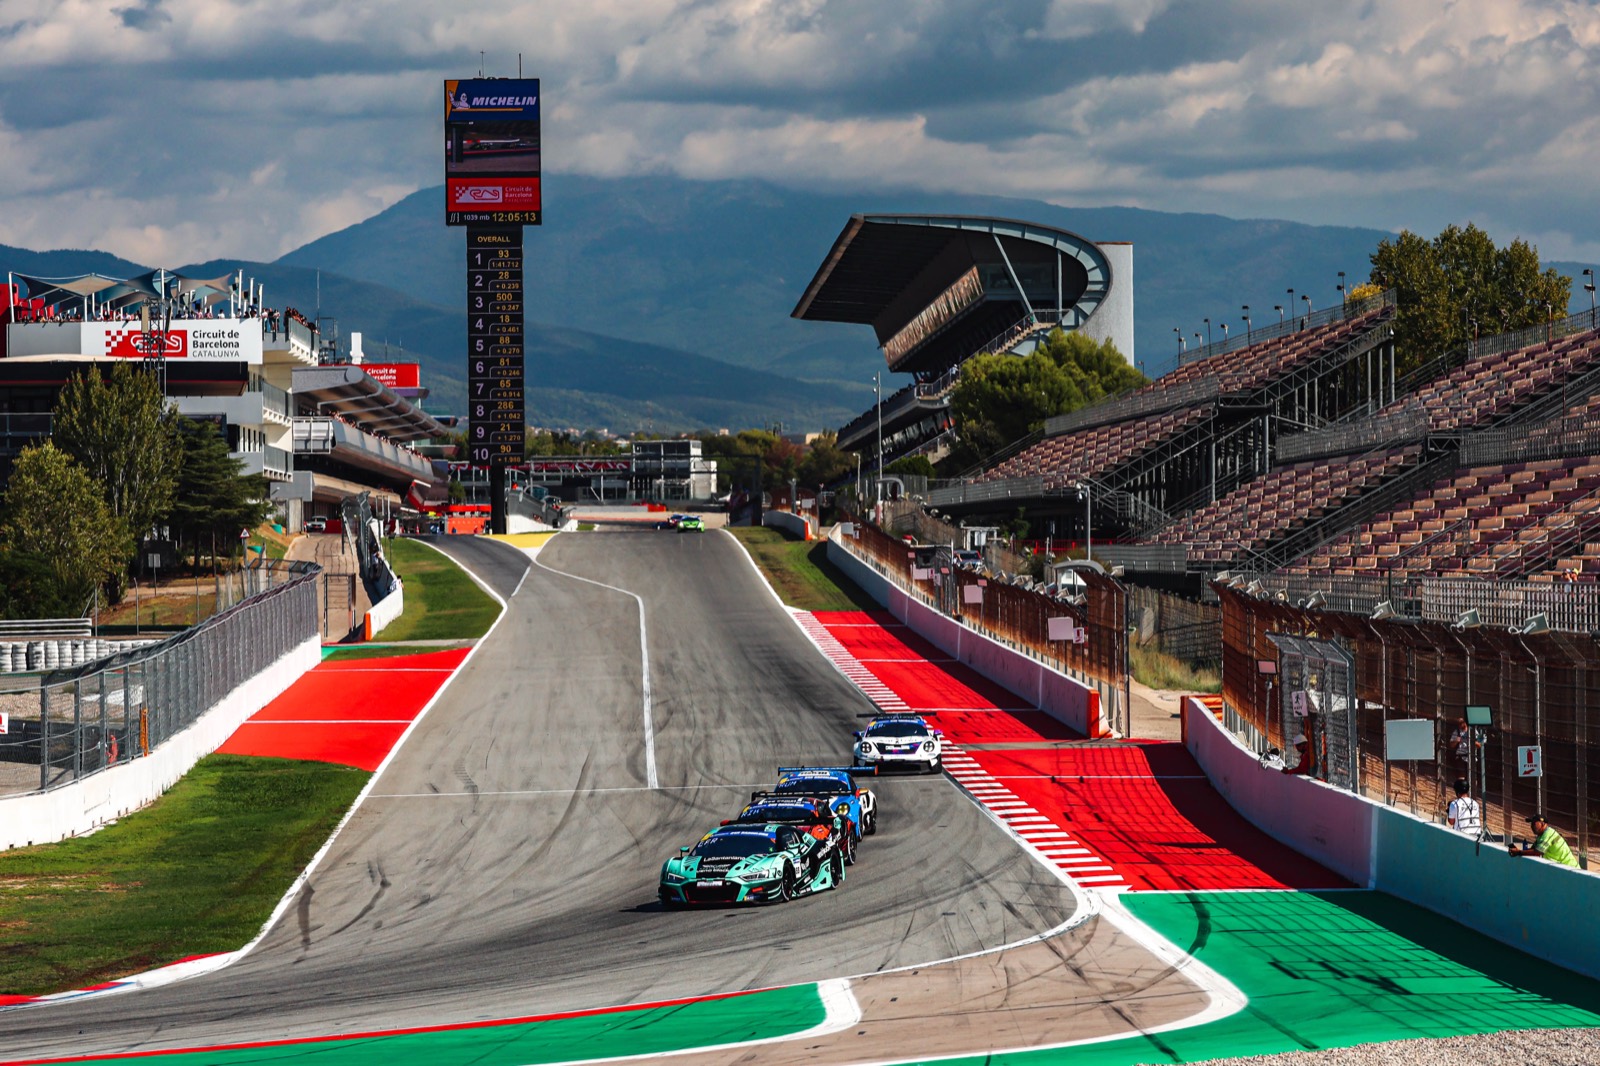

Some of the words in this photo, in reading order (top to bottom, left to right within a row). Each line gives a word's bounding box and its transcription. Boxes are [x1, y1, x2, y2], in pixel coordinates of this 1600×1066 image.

[472, 96, 536, 106] MICHELIN
[493, 212, 536, 221] 12:05:13
[475, 253, 481, 265] 1
[498, 250, 509, 258] 93
[475, 275, 483, 286] 2
[475, 297, 483, 308] 3
[476, 318, 483, 330] 4
[193, 330, 225, 338] Circuit
[228, 330, 239, 338] de
[193, 340, 239, 348] Barcelona
[476, 340, 484, 351] 5
[476, 362, 484, 373] 6
[500, 358, 510, 366] 81
[476, 383, 484, 395] 7
[476, 405, 484, 416] 8
[476, 427, 484, 438] 9
[473, 448, 488, 460] 10
